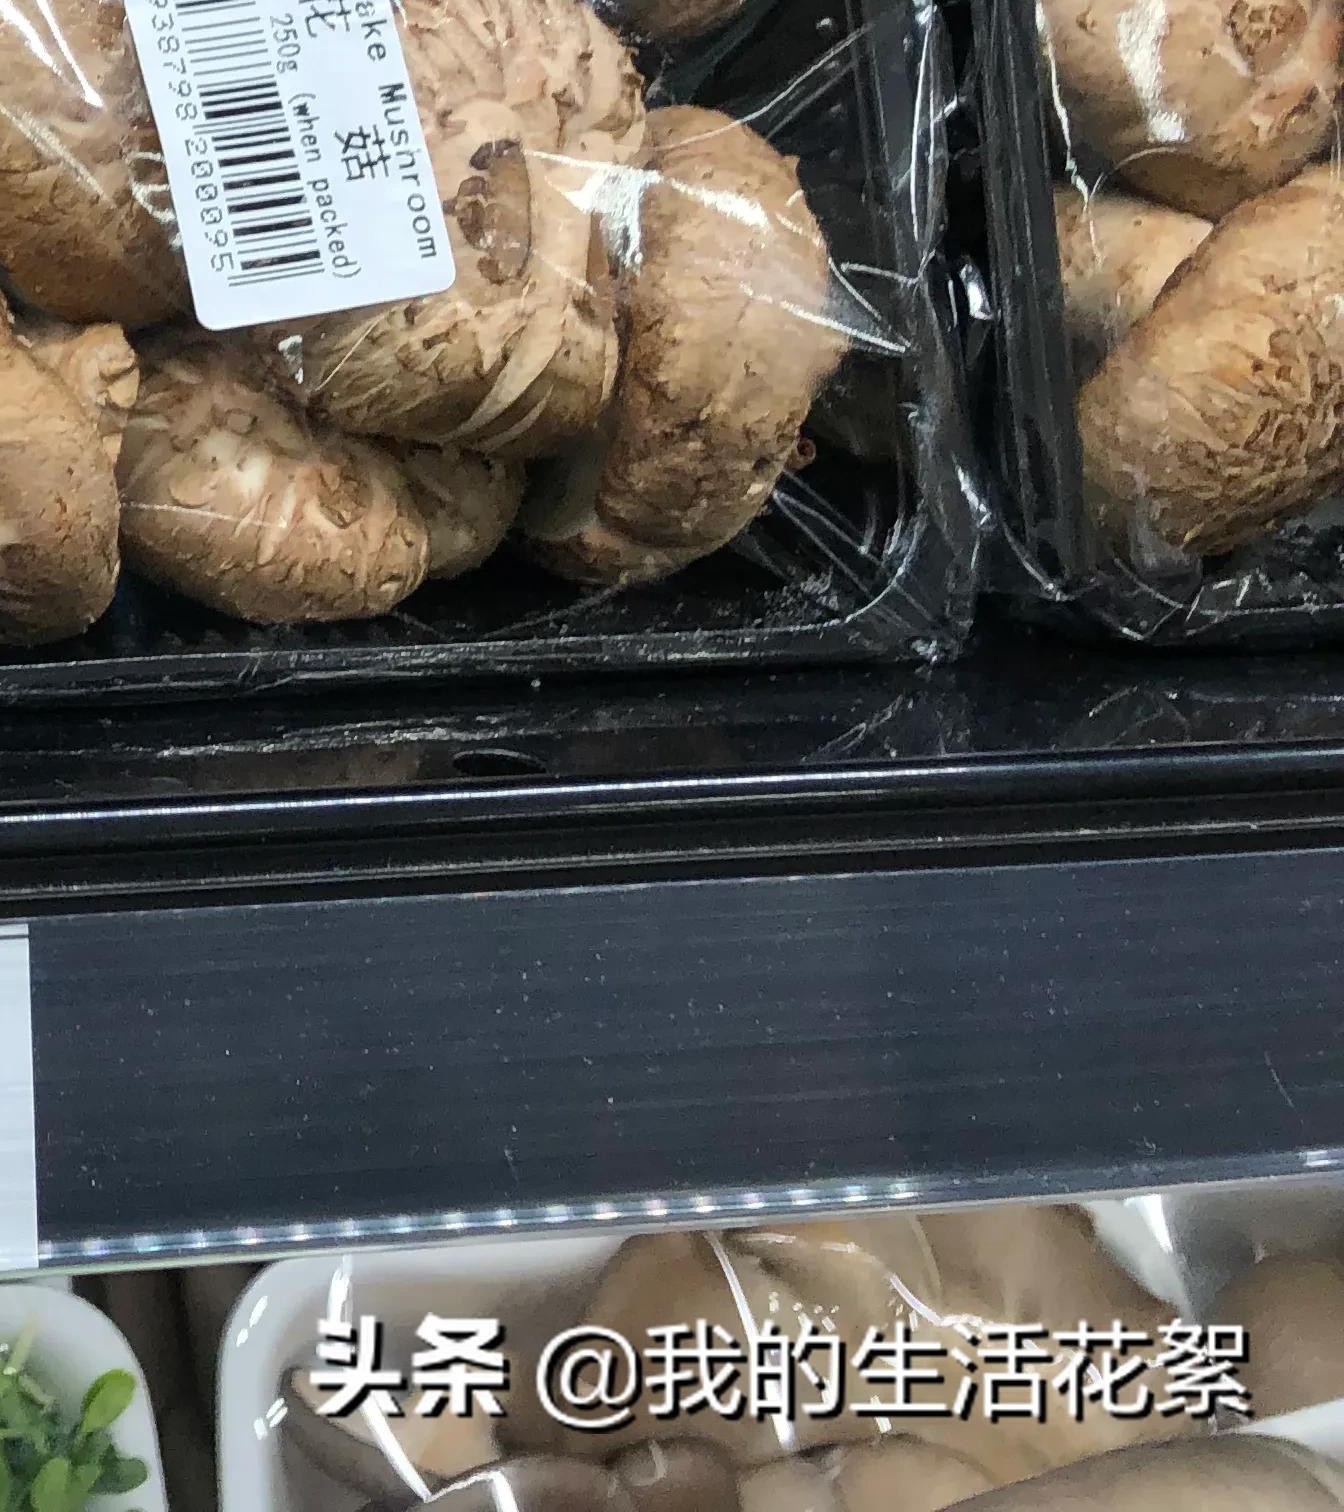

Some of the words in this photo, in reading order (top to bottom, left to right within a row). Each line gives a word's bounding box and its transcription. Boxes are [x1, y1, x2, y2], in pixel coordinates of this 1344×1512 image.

[268, 13, 302, 75] 250g
[290, 90, 322, 165] (when
[376, 81, 439, 260] Mushroom
[305, 176, 363, 280] packed)
